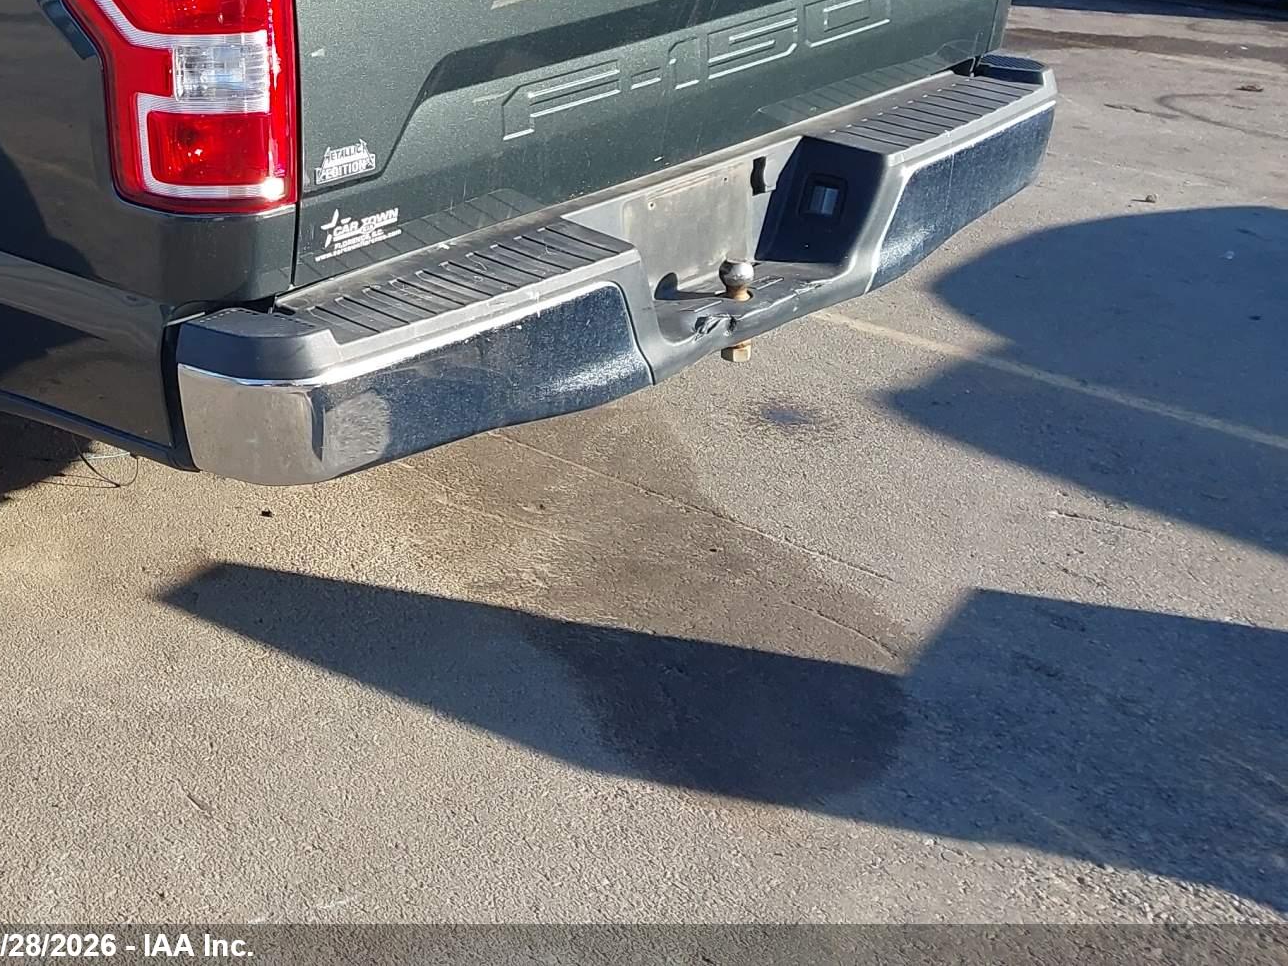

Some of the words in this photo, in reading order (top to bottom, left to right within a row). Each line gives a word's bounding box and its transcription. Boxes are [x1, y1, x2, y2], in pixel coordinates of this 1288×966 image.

[325, 159, 367, 180] EDITION
[333, 221, 359, 236] CAR
[361, 207, 399, 227] TOWN
